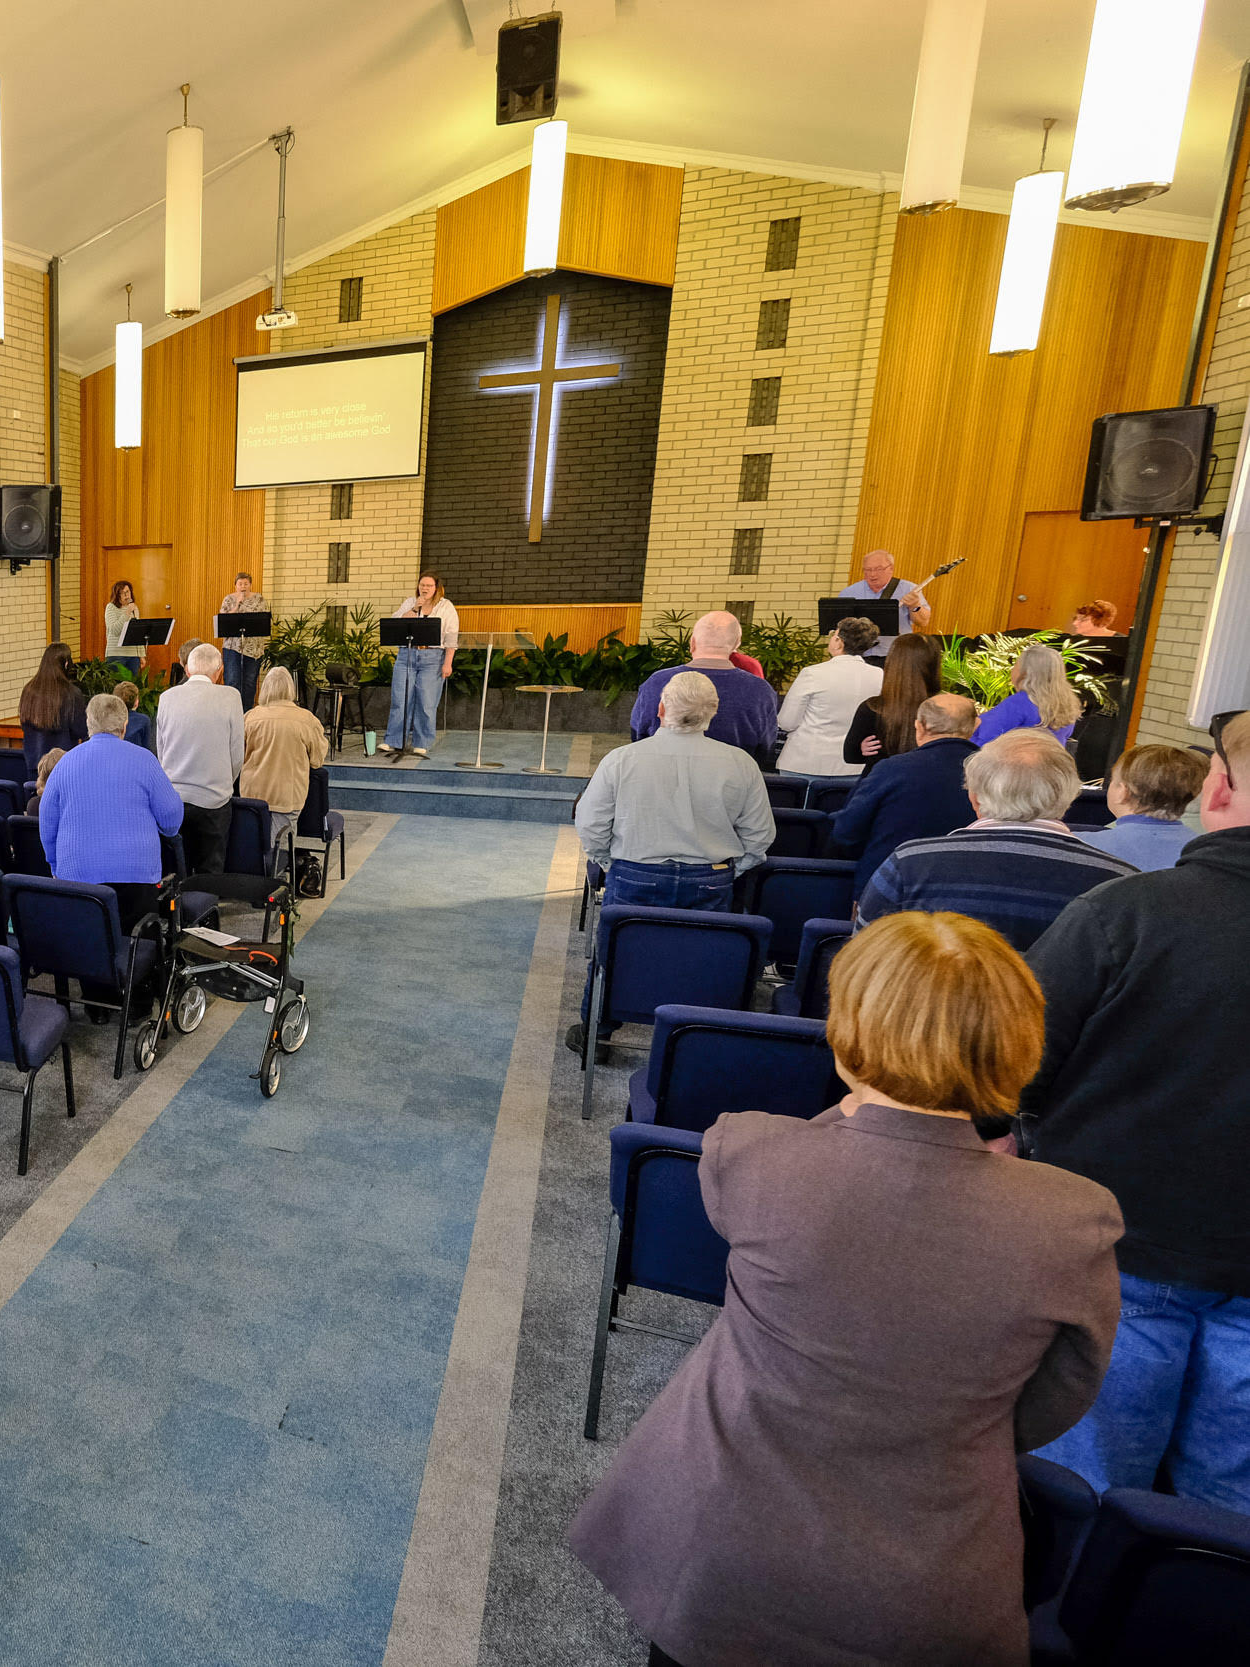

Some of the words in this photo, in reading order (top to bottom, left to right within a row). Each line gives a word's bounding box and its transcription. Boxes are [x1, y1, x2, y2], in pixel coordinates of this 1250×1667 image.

[310, 407, 318, 417] is
[321, 405, 339, 417] very
[246, 425, 264, 435] And
[334, 417, 346, 426] be
[279, 434, 299, 445] God
[372, 423, 391, 435] God
